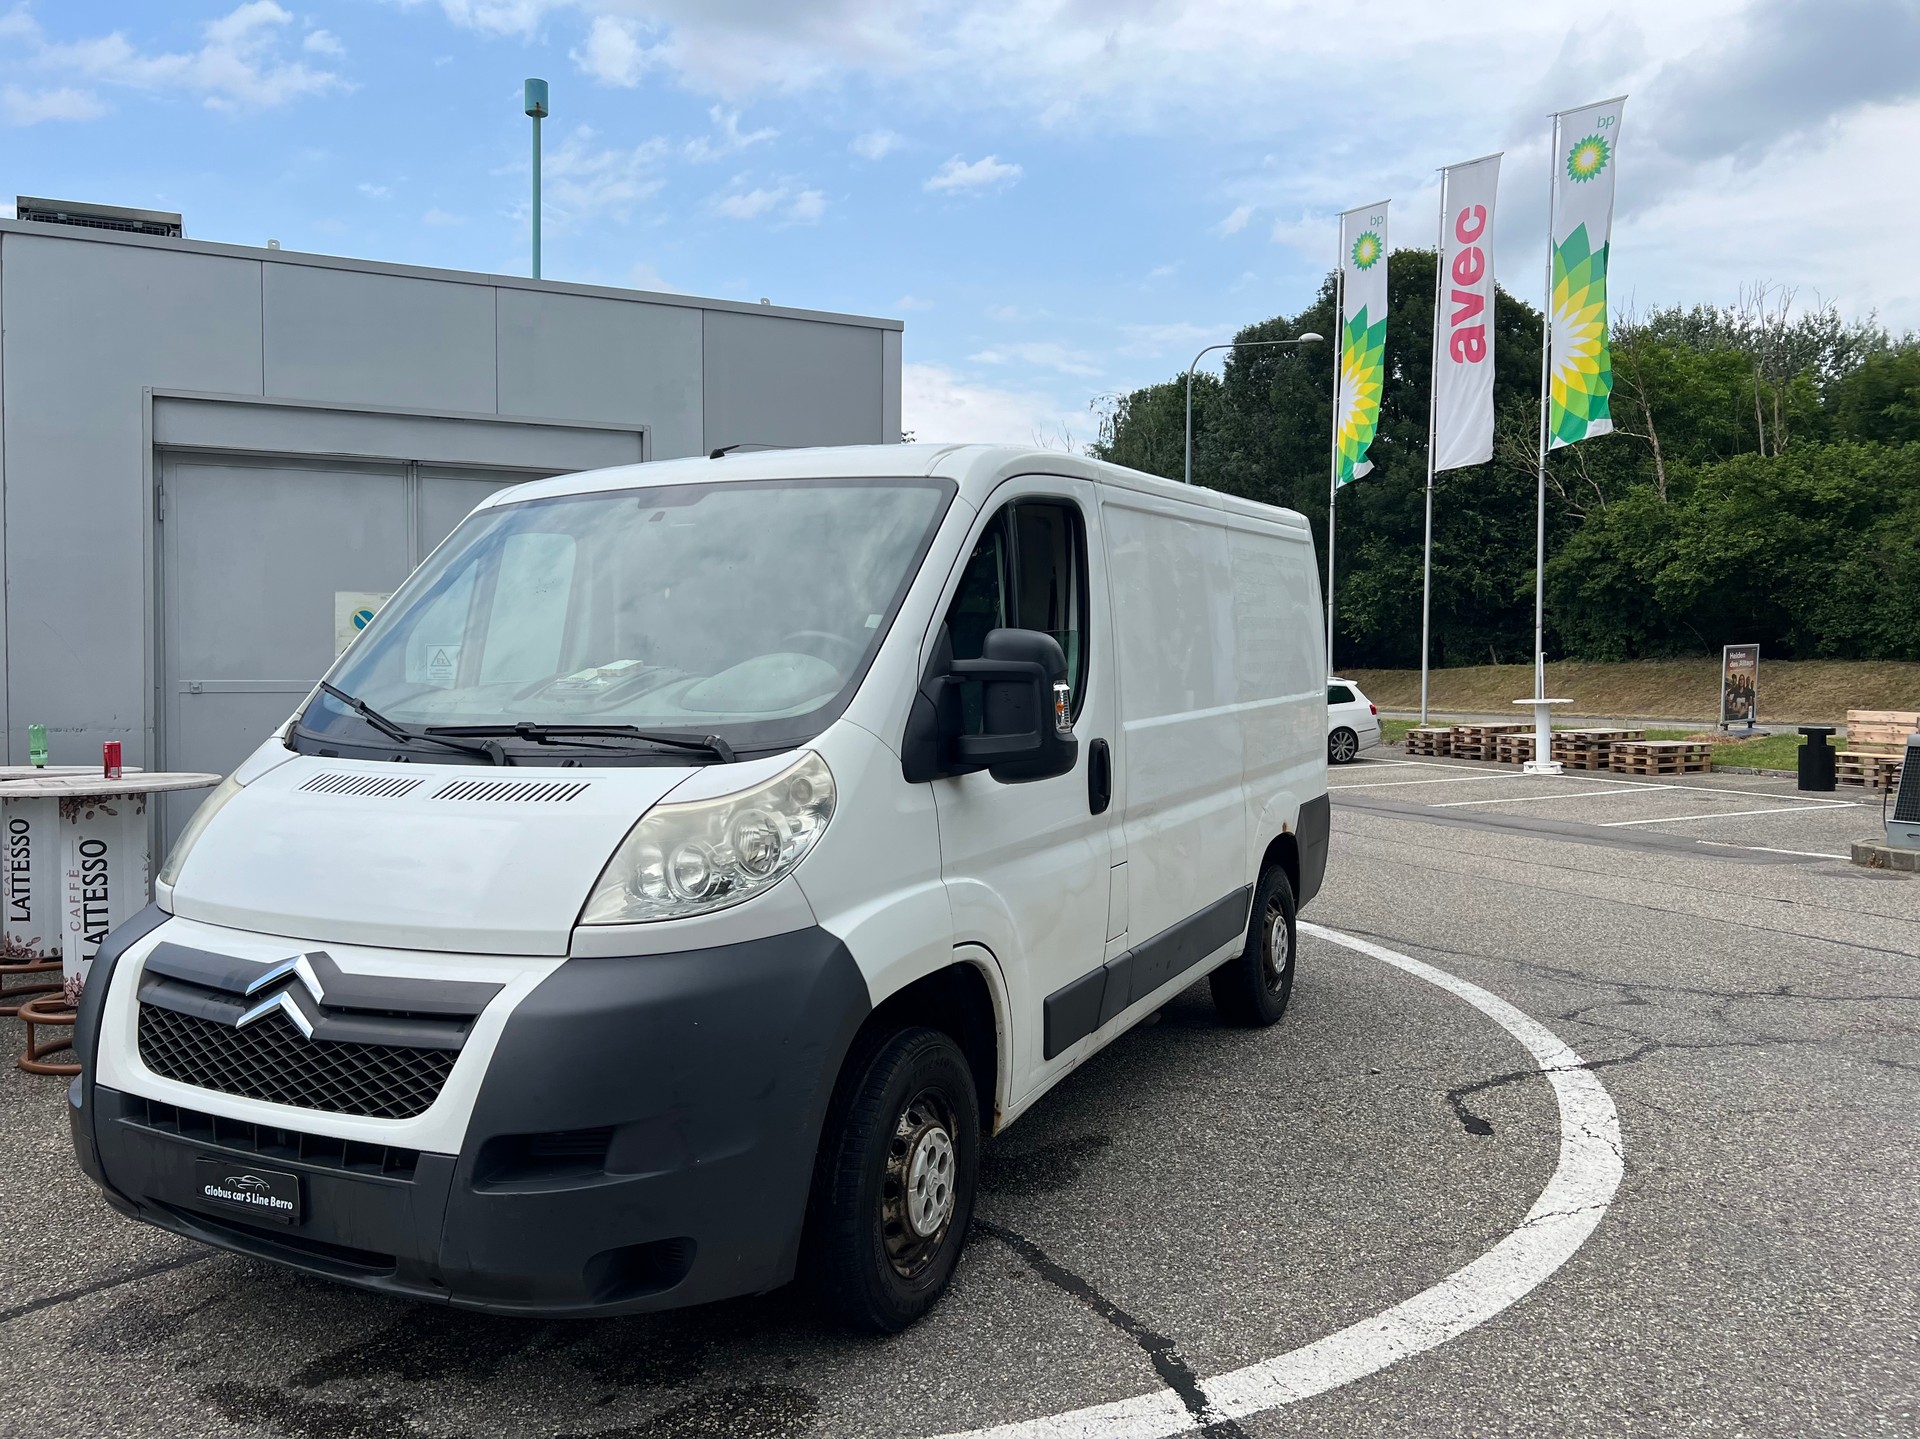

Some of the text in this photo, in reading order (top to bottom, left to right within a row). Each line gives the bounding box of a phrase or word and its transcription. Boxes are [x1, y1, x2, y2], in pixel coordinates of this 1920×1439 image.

[1597, 115, 1615, 129] bp
[1370, 215, 1384, 227] bp
[1450, 204, 1487, 364] avec
[9, 818, 30, 922] LATTESSO
[204, 1184, 294, 1210] Globus car S Line Berro
